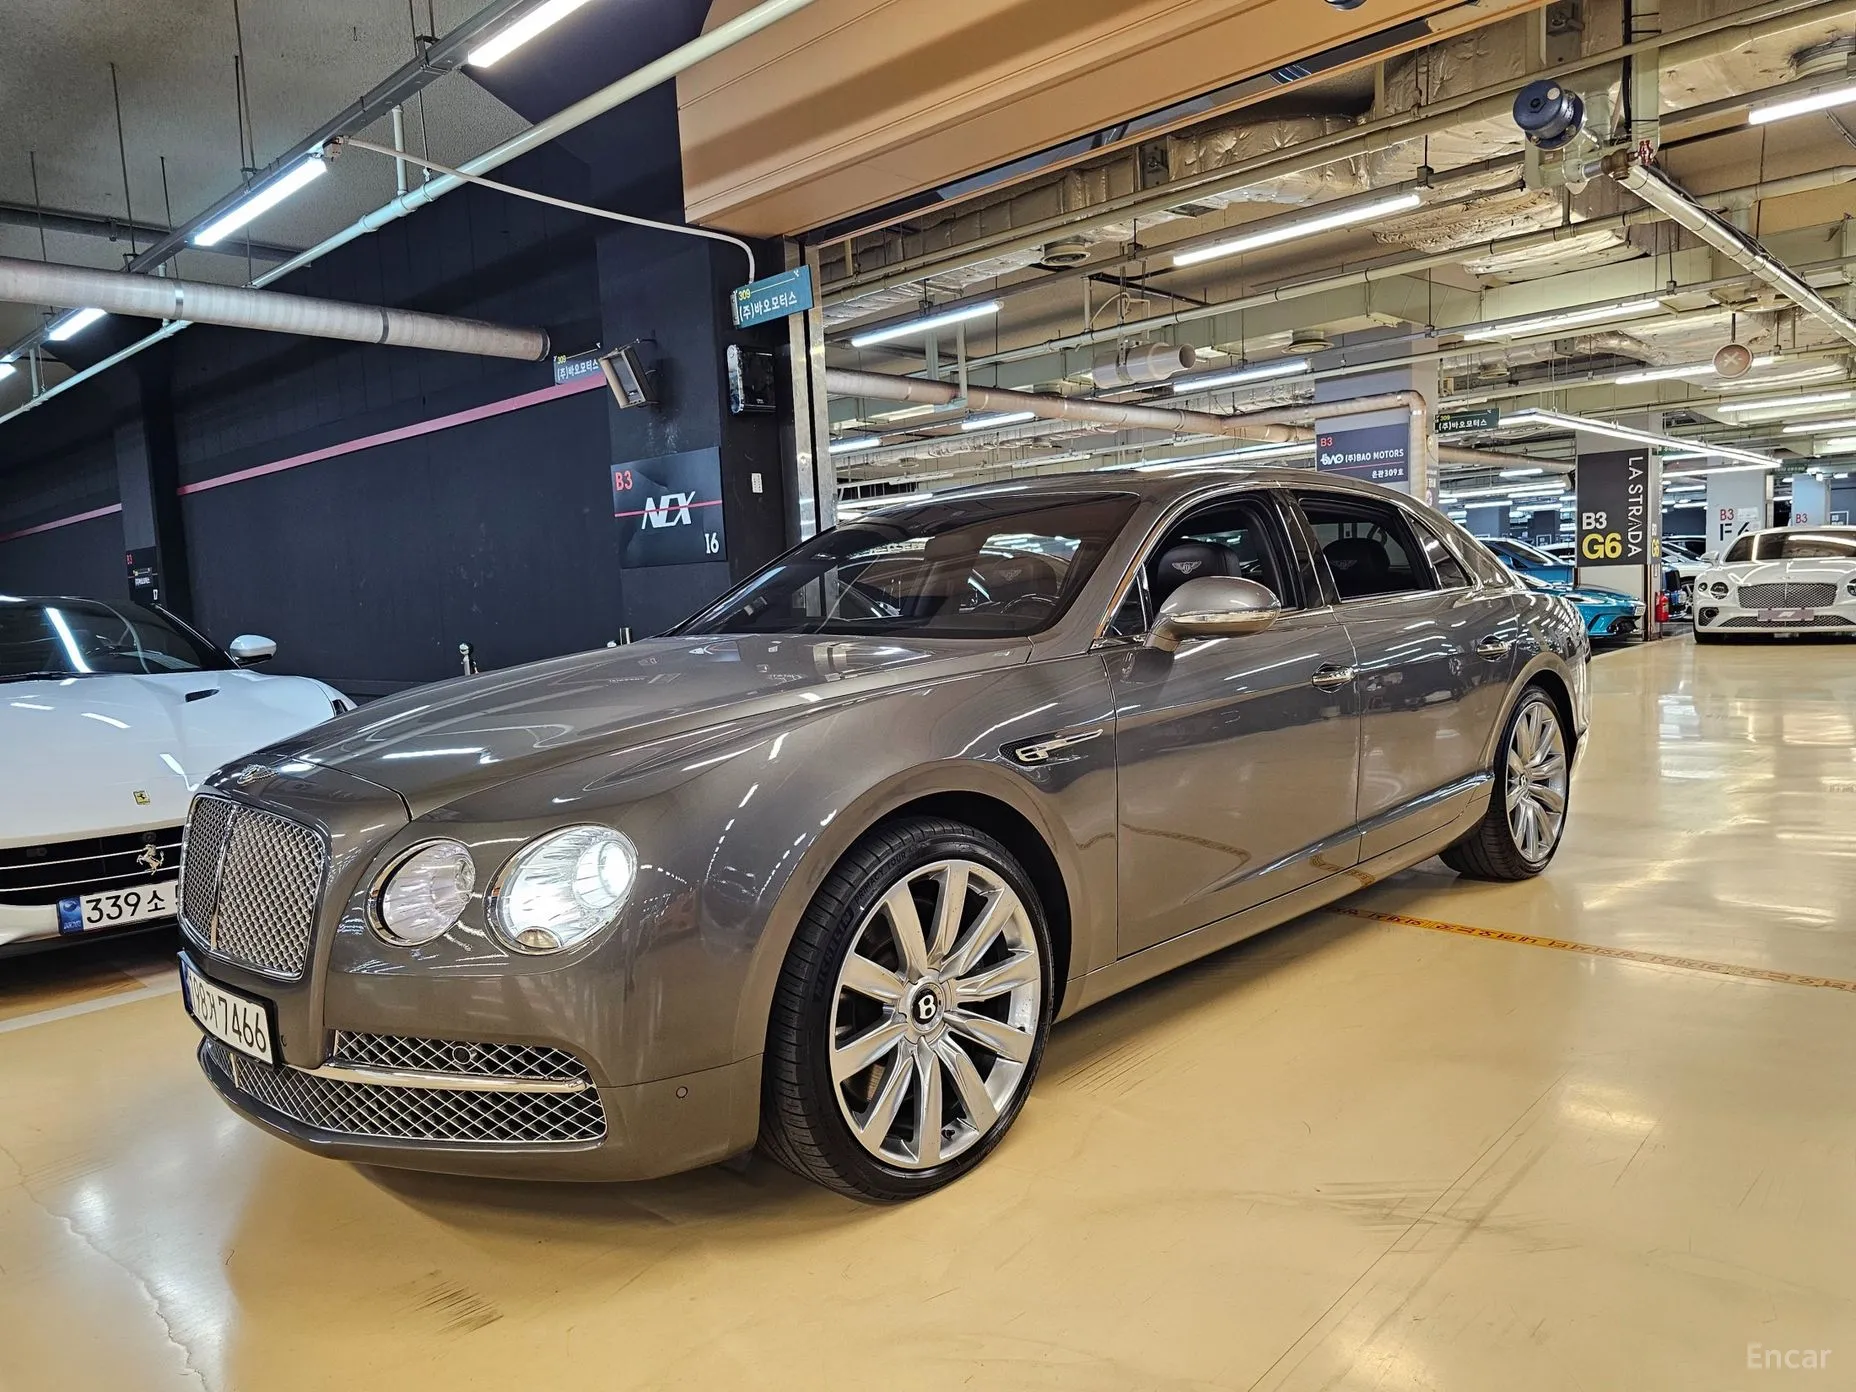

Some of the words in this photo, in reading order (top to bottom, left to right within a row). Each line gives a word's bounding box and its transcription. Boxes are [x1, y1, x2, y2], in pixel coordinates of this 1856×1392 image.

[738, 289, 751, 301] 309
[740, 290, 798, 322] (주)바오모터스
[557, 359, 599, 380] (주)바오모터스
[1439, 419, 1488, 430] (주)바오모터스
[1320, 437, 1333, 447] B3
[1373, 449, 1405, 459] MOTORS
[1628, 456, 1644, 480] LA
[615, 470, 633, 491] B3
[1582, 512, 1607, 530] B3
[1627, 484, 1643, 557] STRADA
[1720, 509, 1734, 520] B3
[1796, 514, 1808, 524] B3
[1582, 532, 1622, 559] G6
[86, 890, 166, 924] 339소
